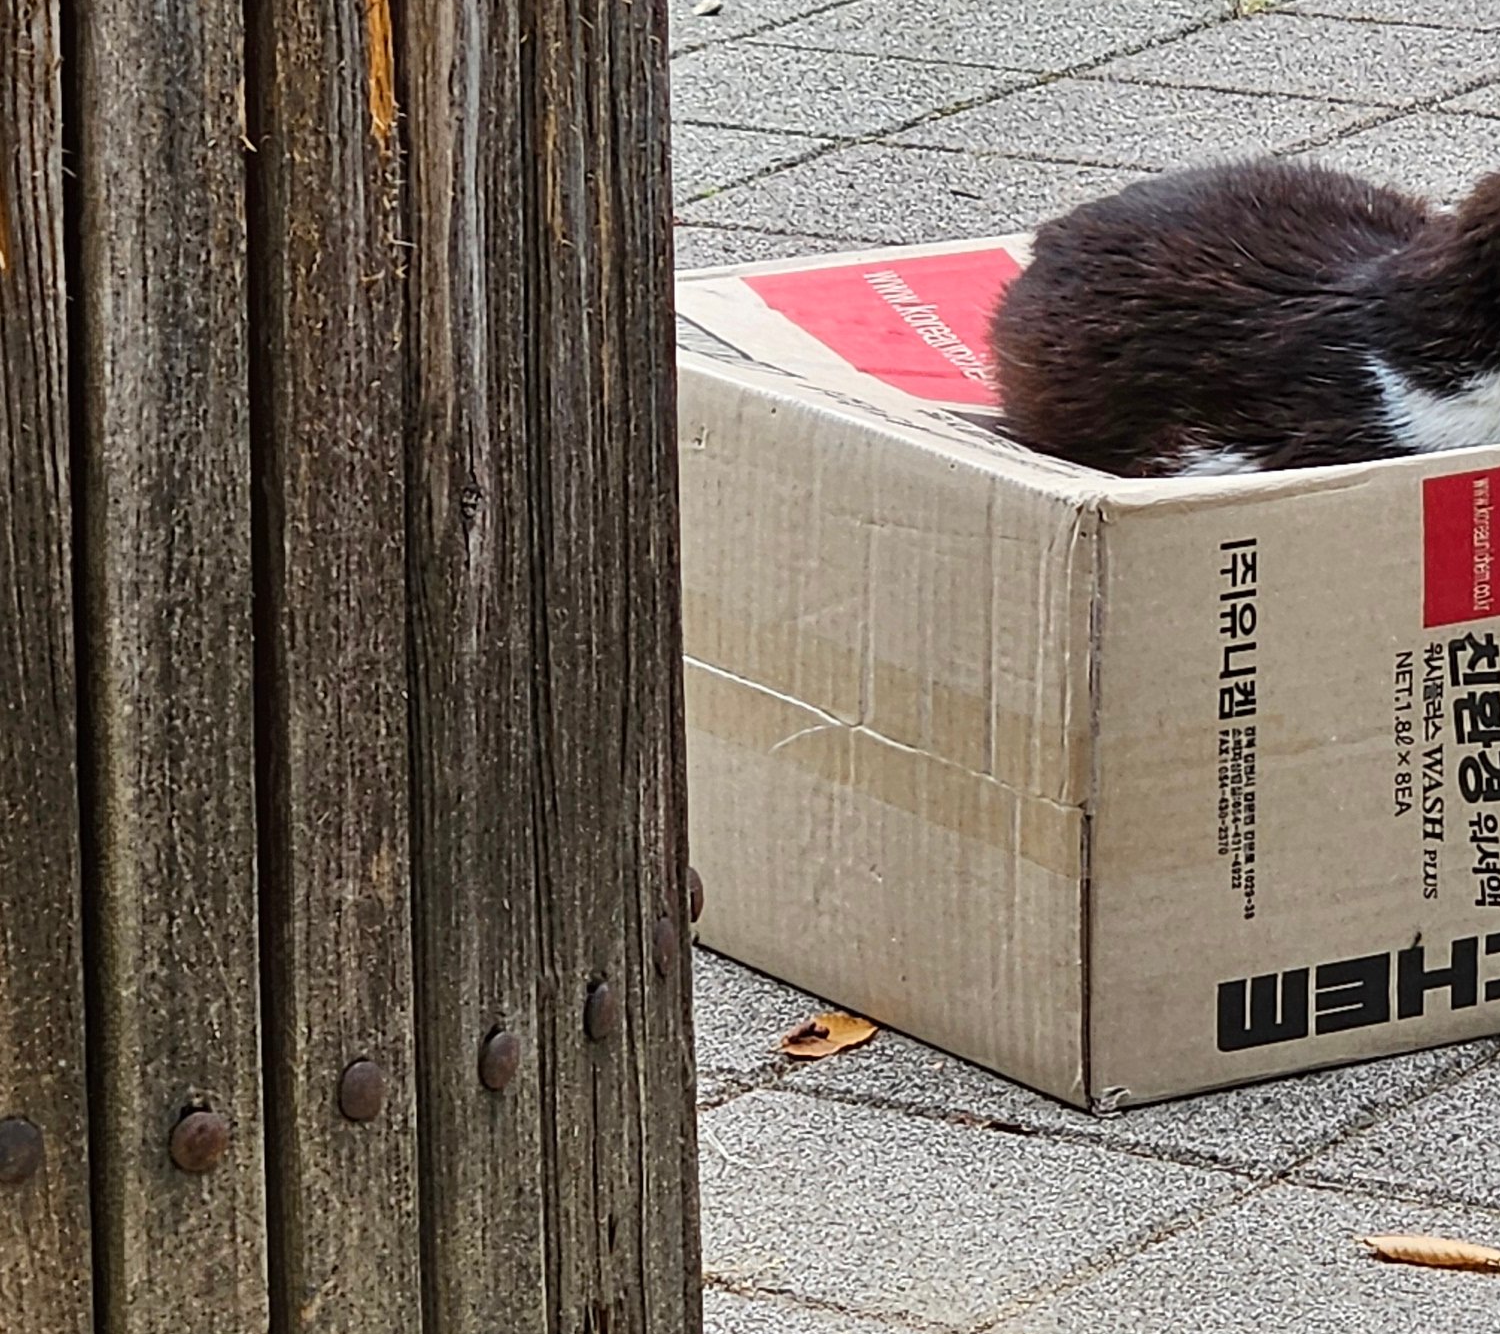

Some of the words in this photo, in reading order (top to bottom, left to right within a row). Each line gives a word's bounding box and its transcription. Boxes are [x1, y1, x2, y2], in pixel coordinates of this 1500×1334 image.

[1423, 643, 1444, 741] 워시플러스
[1422, 743, 1444, 842] WASH
[1423, 849, 1438, 900] PLUS
